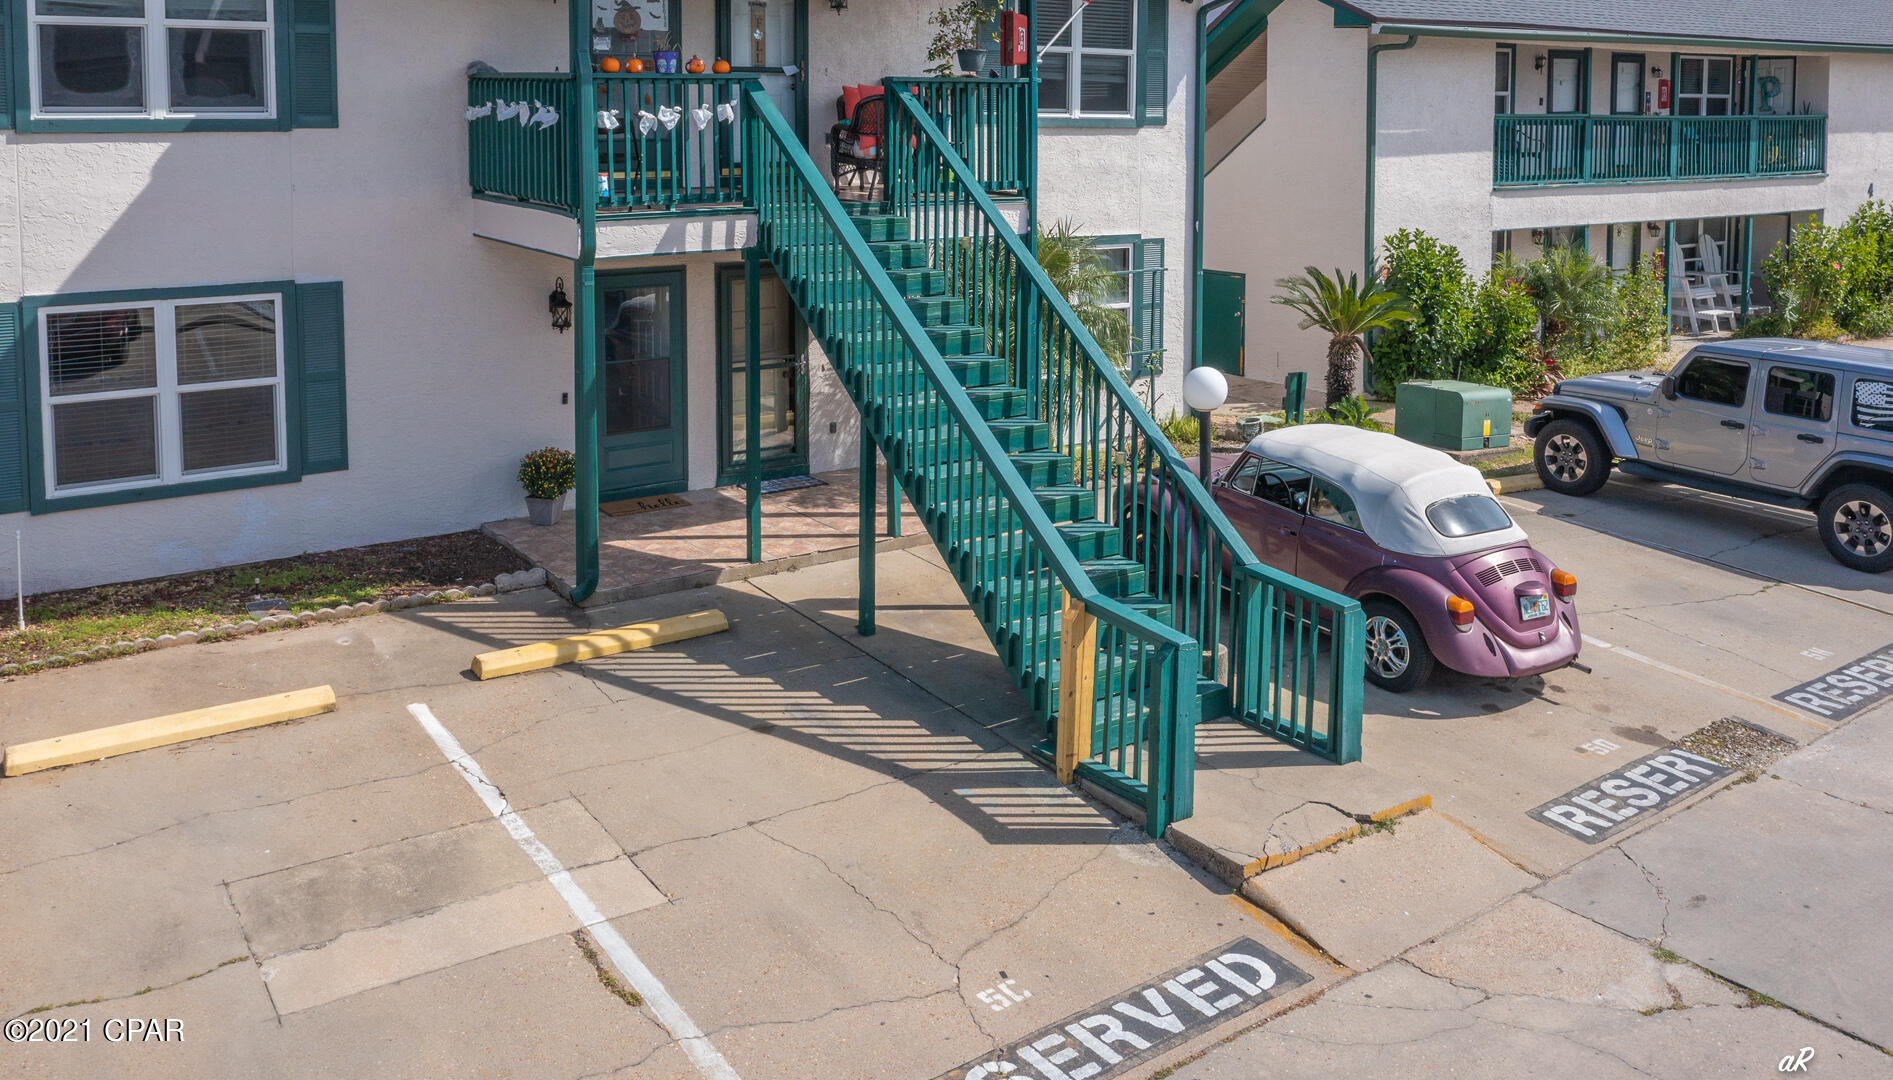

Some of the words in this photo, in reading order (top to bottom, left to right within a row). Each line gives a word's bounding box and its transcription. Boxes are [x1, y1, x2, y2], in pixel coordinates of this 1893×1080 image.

[754, 17, 763, 63] FLL
[1758, 76, 1781, 112] P
[1785, 650, 1893, 716] RESER
